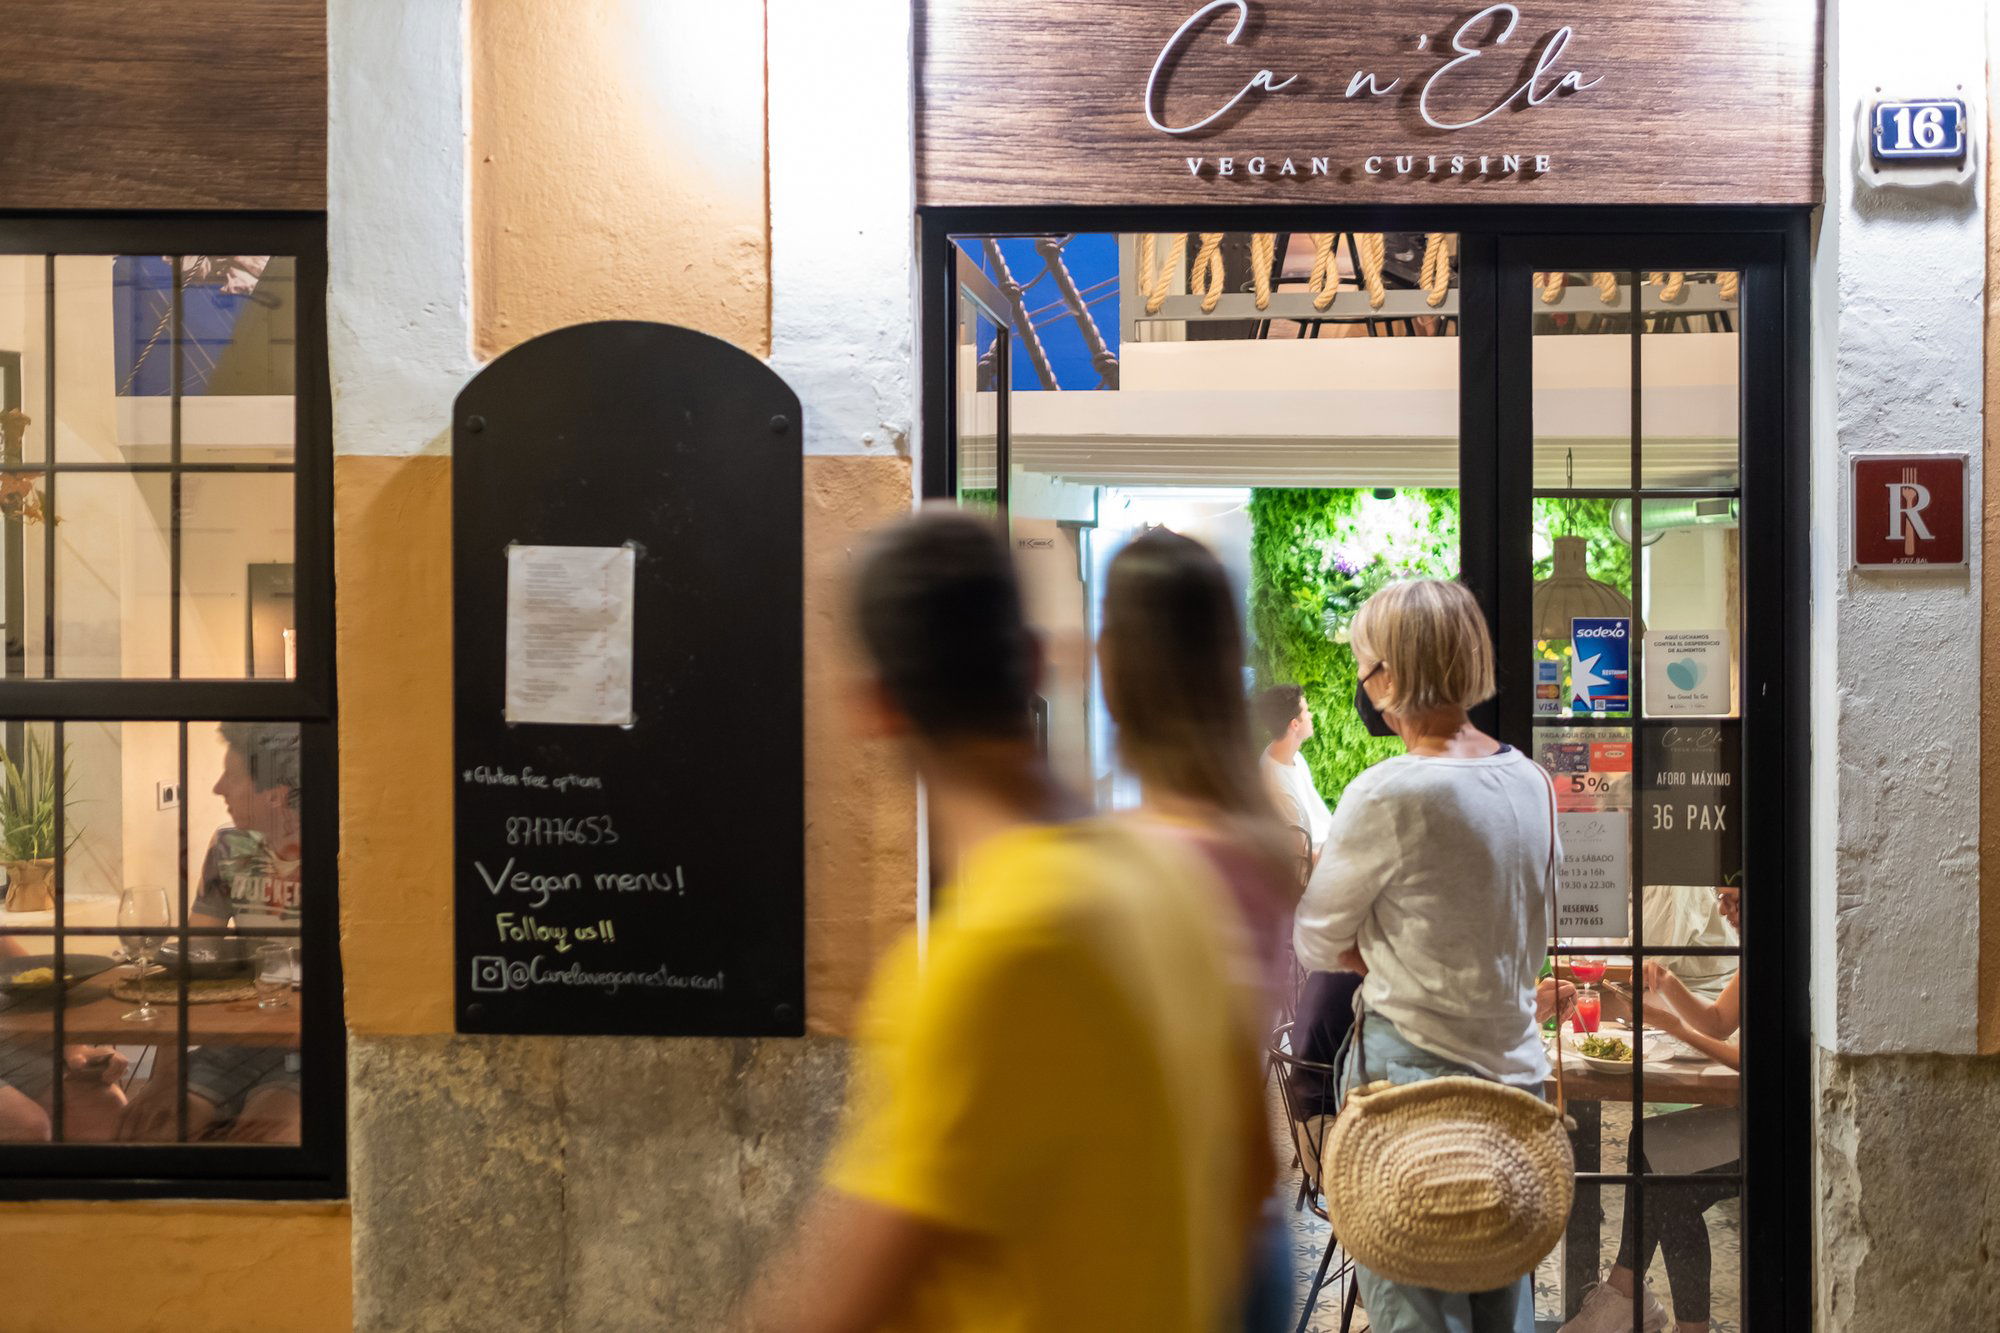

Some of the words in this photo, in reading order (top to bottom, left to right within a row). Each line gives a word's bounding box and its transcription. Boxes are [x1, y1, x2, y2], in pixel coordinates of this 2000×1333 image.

[1893, 107, 1945, 150] 16
[1187, 157, 1329, 176] VEGAN
[1365, 155, 1551, 175] CUISINE
[1885, 483, 1936, 541] R
[1576, 624, 1626, 638] sodexo
[1539, 703, 1559, 711] VISA
[1571, 774, 1610, 793] 5%
[1656, 771, 1686, 786] AFORO
[1691, 770, 1731, 786] MÁXIMO
[1652, 804, 1674, 830] 36
[1687, 804, 1727, 831] PAX
[1571, 868, 1581, 876] 13
[1590, 868, 1605, 876] 16h
[474, 857, 581, 908] Vegan
[594, 865, 684, 896] menu!
[1562, 904, 1599, 913] RESERVAS
[496, 912, 568, 942] Follow
[1560, 917, 1573, 926] 871
[1574, 917, 1588, 926] 776
[1589, 917, 1604, 926] 653
